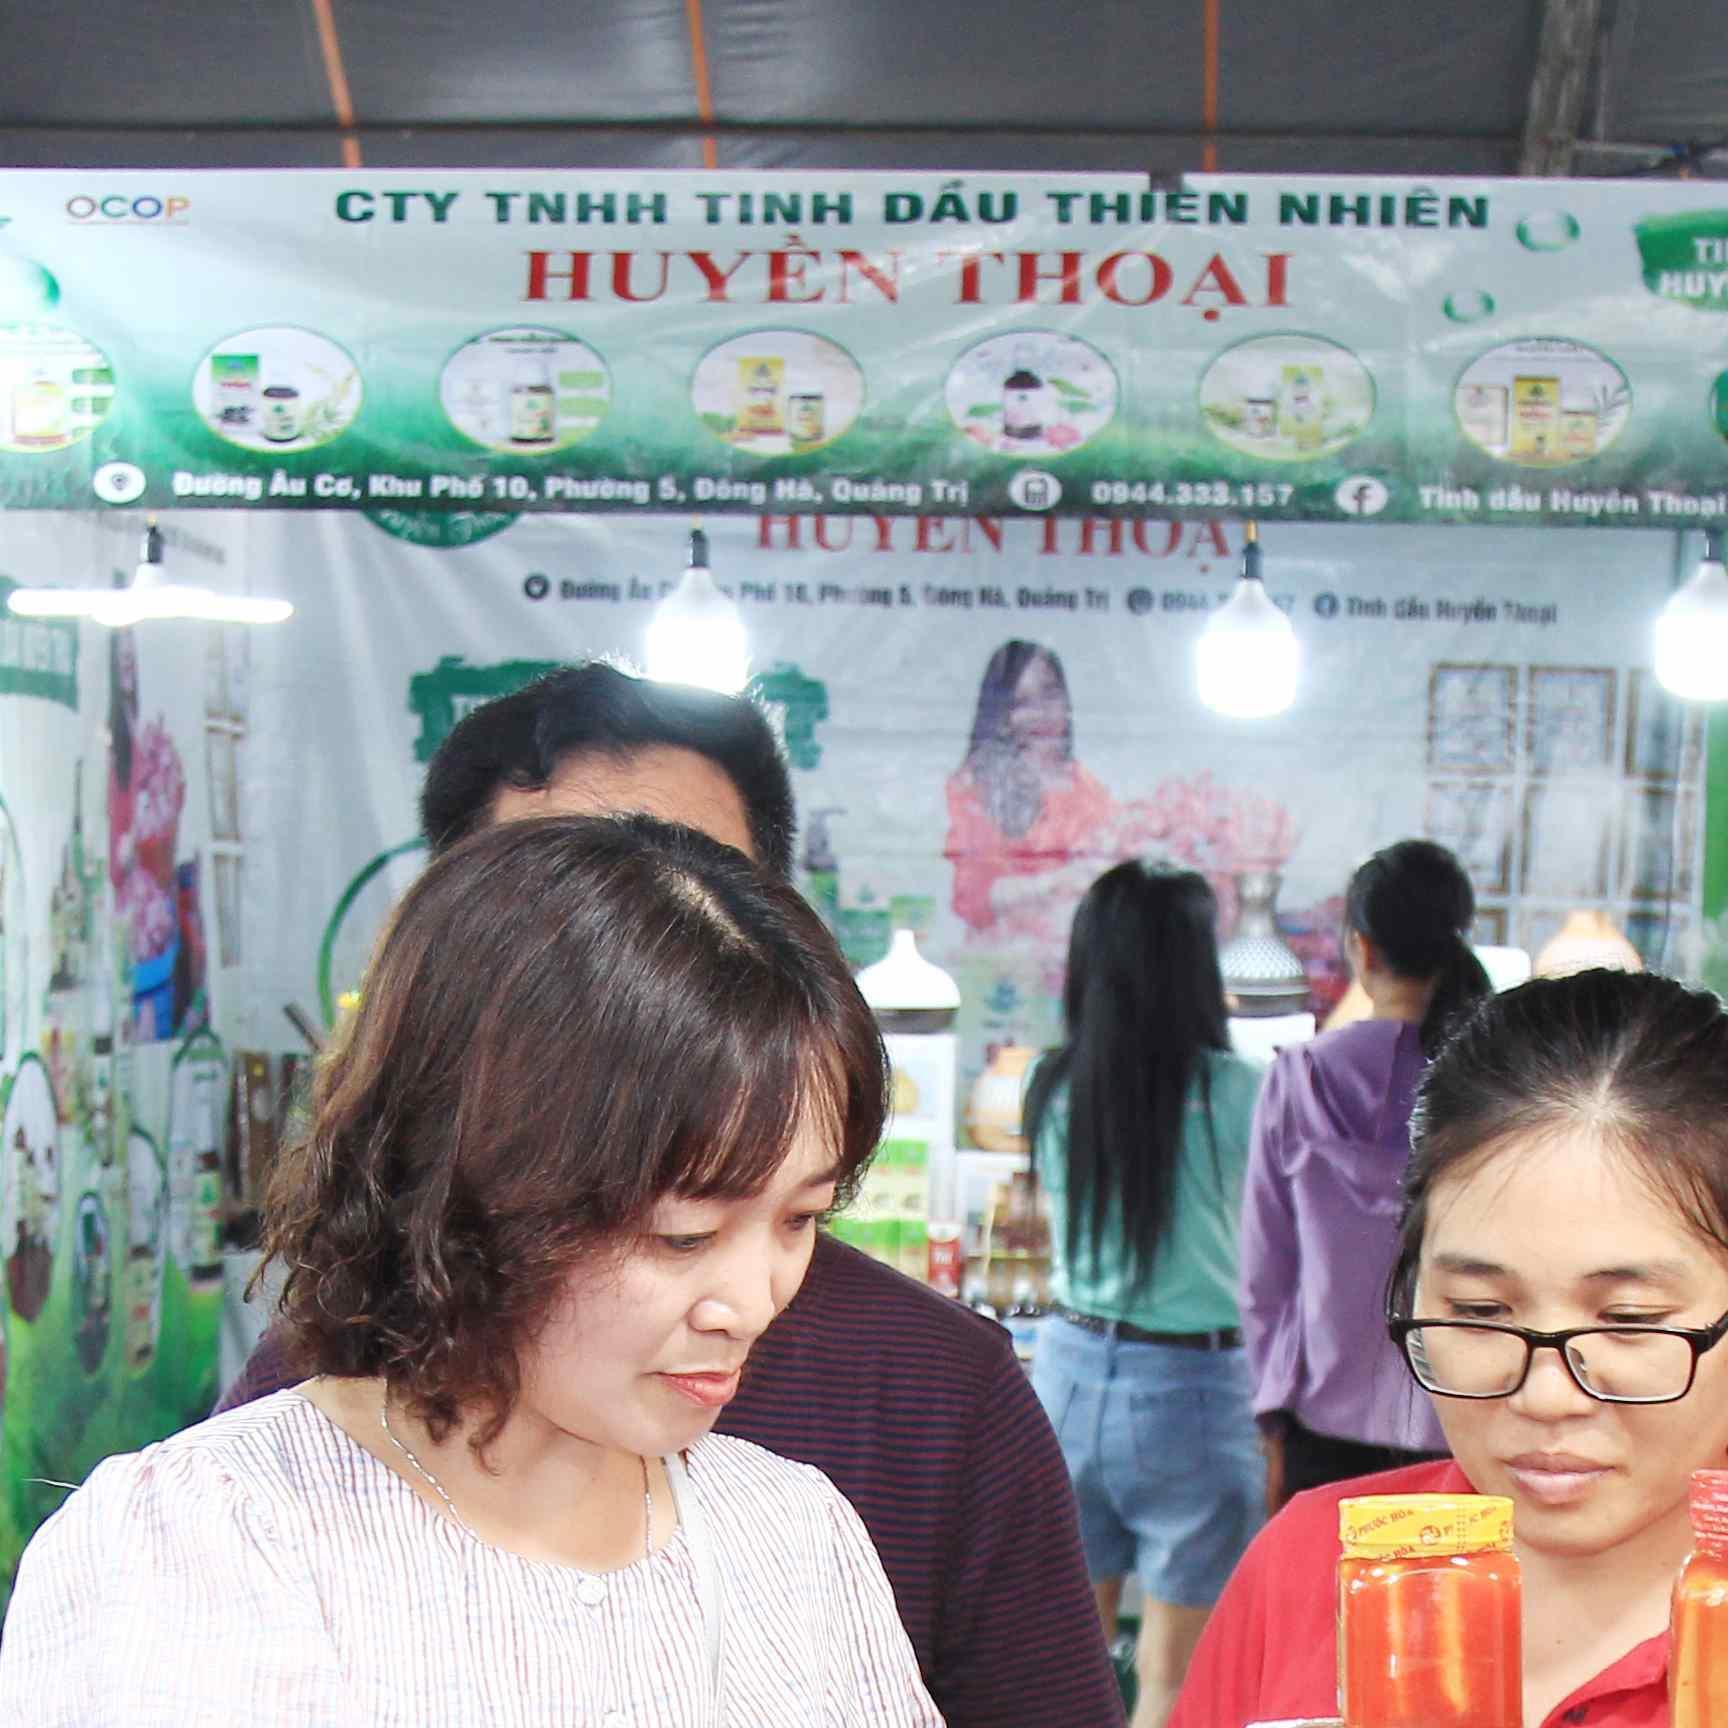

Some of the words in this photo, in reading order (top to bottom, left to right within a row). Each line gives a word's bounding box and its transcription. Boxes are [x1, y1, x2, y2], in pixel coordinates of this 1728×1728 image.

[67, 194, 190, 219] OCOP
[335, 191, 459, 223] CTY
[486, 191, 664, 224] TNHH
[697, 191, 852, 225] TINH
[1279, 187, 1489, 229] NHIÊN
[524, 234, 900, 304] HUYỀN
[938, 250, 1295, 321] THOẠI
[269, 467, 308, 499] Âu
[314, 471, 362, 501] Cơ,
[369, 471, 422, 500] Khu
[429, 470, 482, 500] Phố
[493, 475, 537, 504] 10,
[544, 474, 649, 507] Phường
[658, 477, 685, 504] 5,
[830, 474, 922, 508] Quảng
[930, 477, 970, 508] Trị
[1091, 482, 1295, 508] 0944.333.157
[1418, 484, 1479, 512] Tinh
